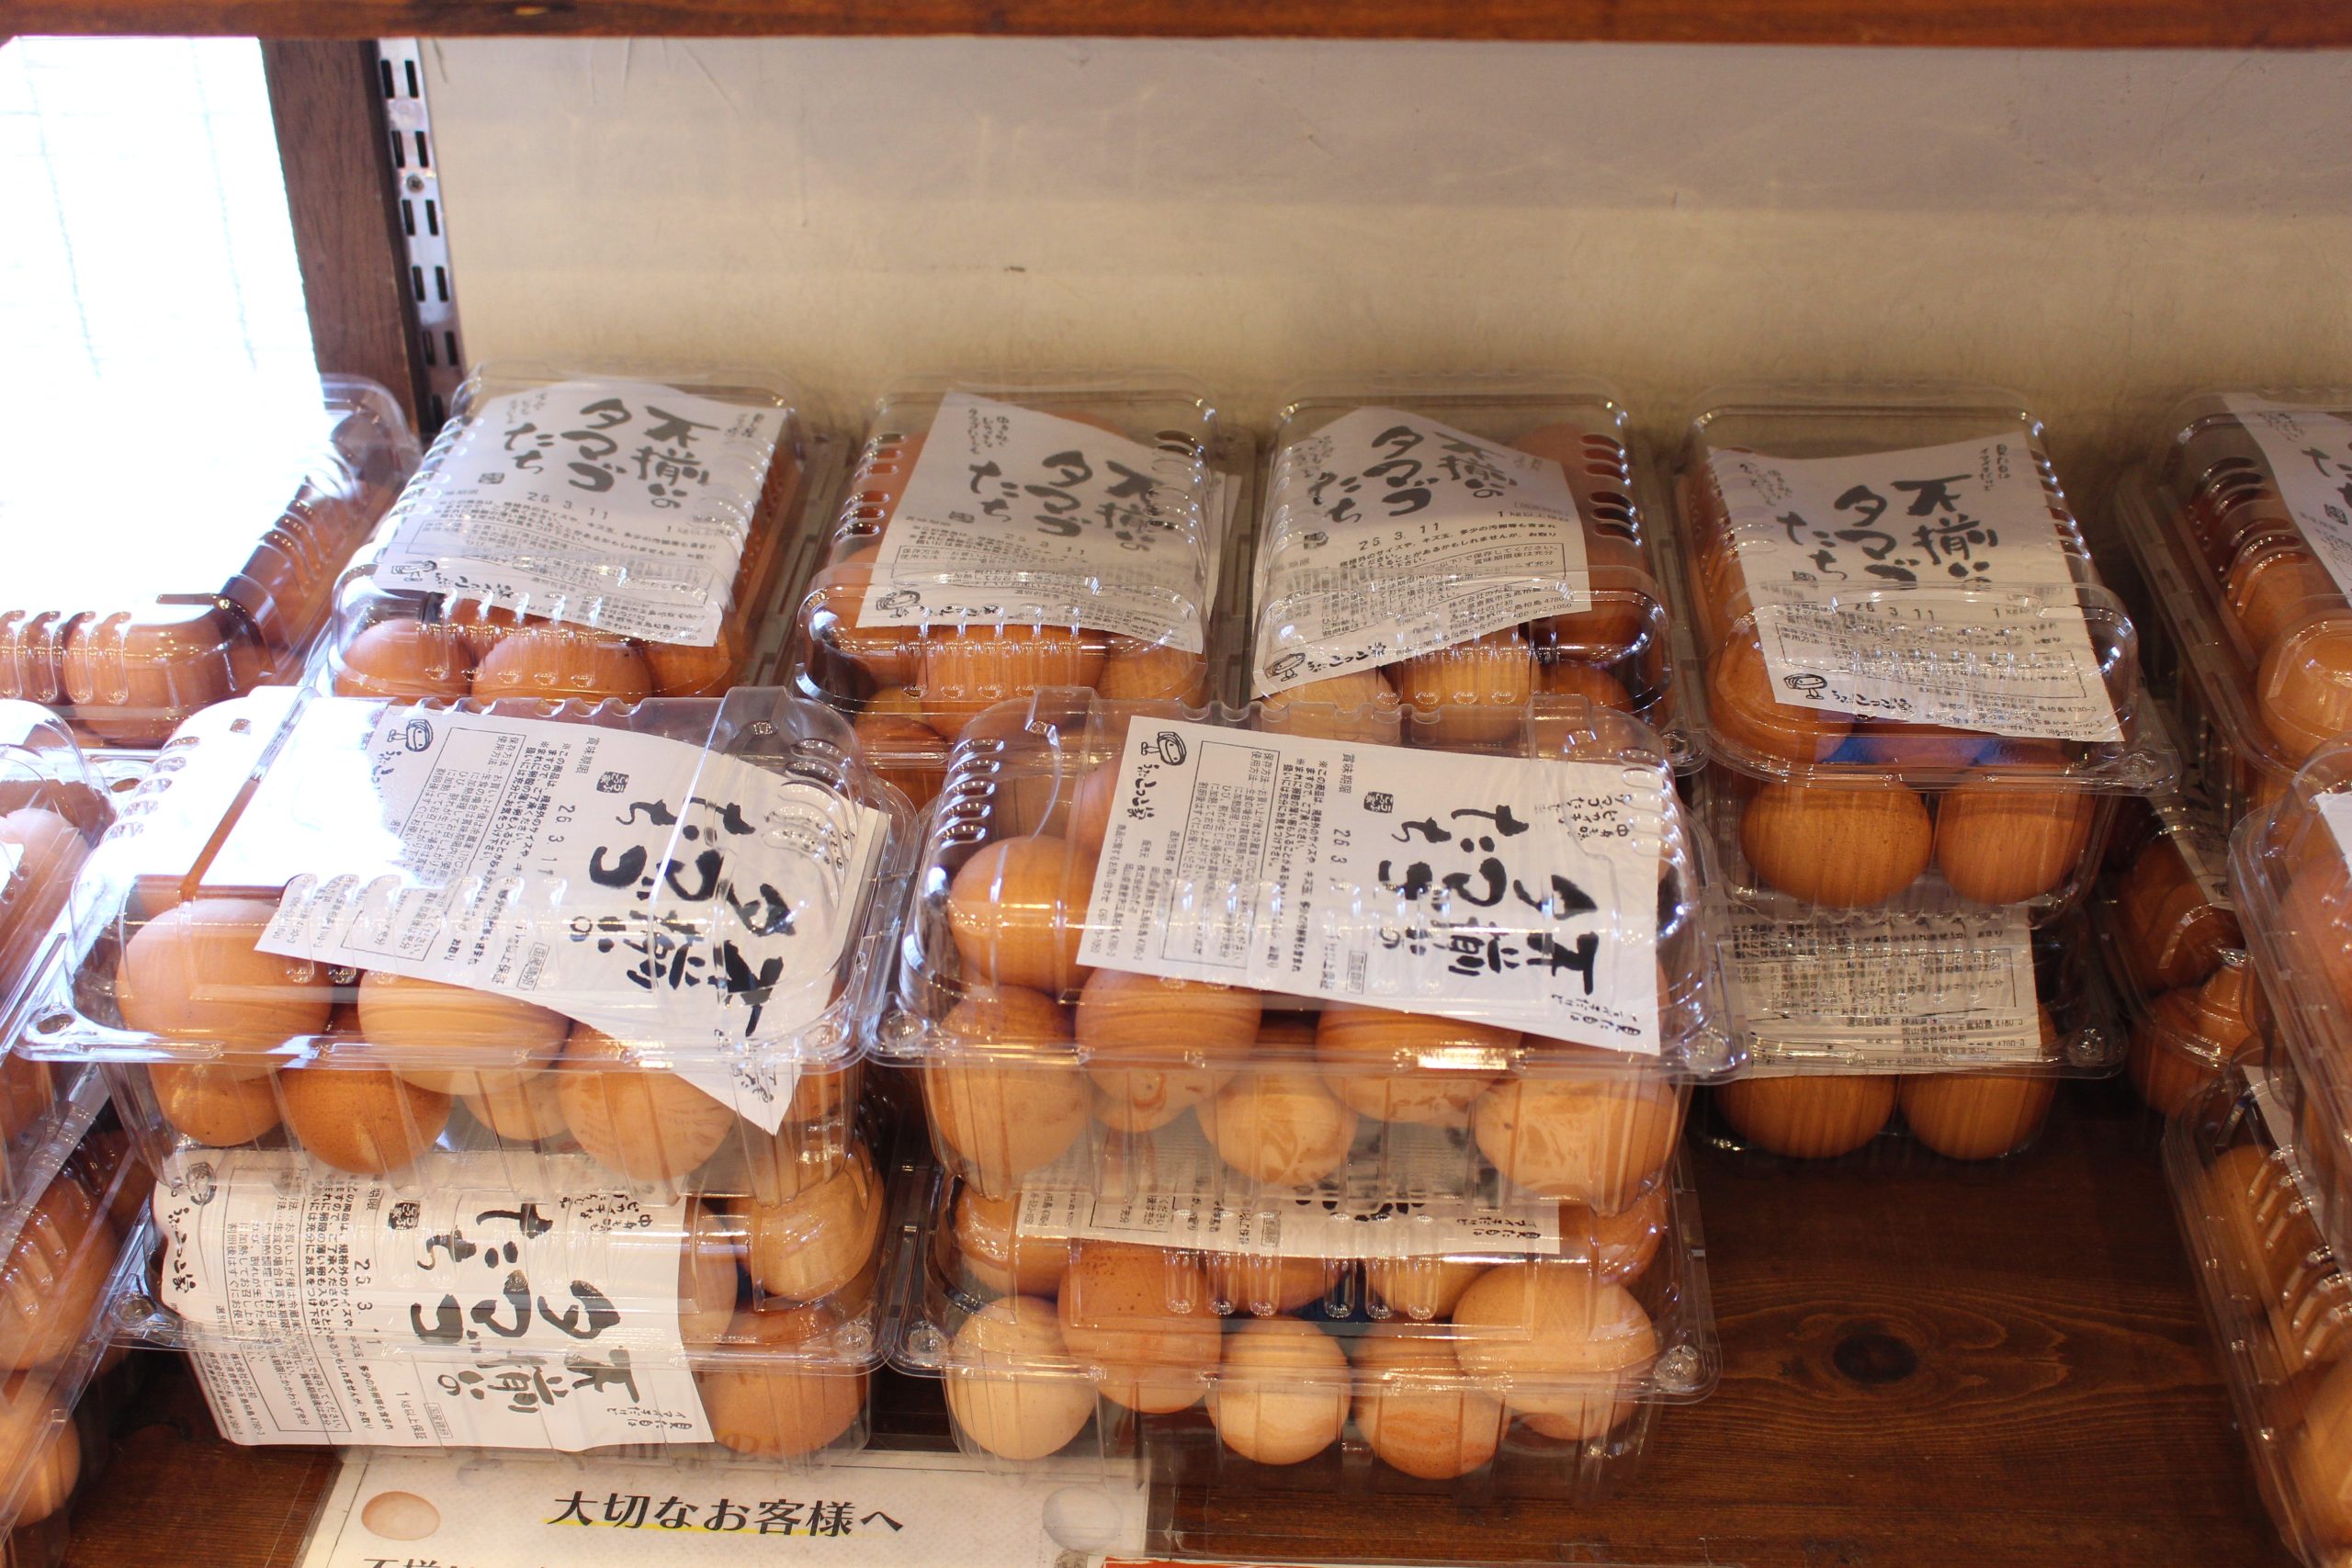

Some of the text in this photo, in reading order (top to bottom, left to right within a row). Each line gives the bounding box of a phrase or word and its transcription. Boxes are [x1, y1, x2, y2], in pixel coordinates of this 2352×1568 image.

[560, 397, 632, 493] タマゴ
[1363, 425, 1440, 516] タマゴ
[1025, 450, 1094, 538] タマゴ
[575, 736, 600, 775] 賞味期限
[1338, 753, 1355, 794] 賞味期限
[411, 1269, 621, 1353] タマゴ
[547, 1490, 904, 1538] 大切なお客様へ
